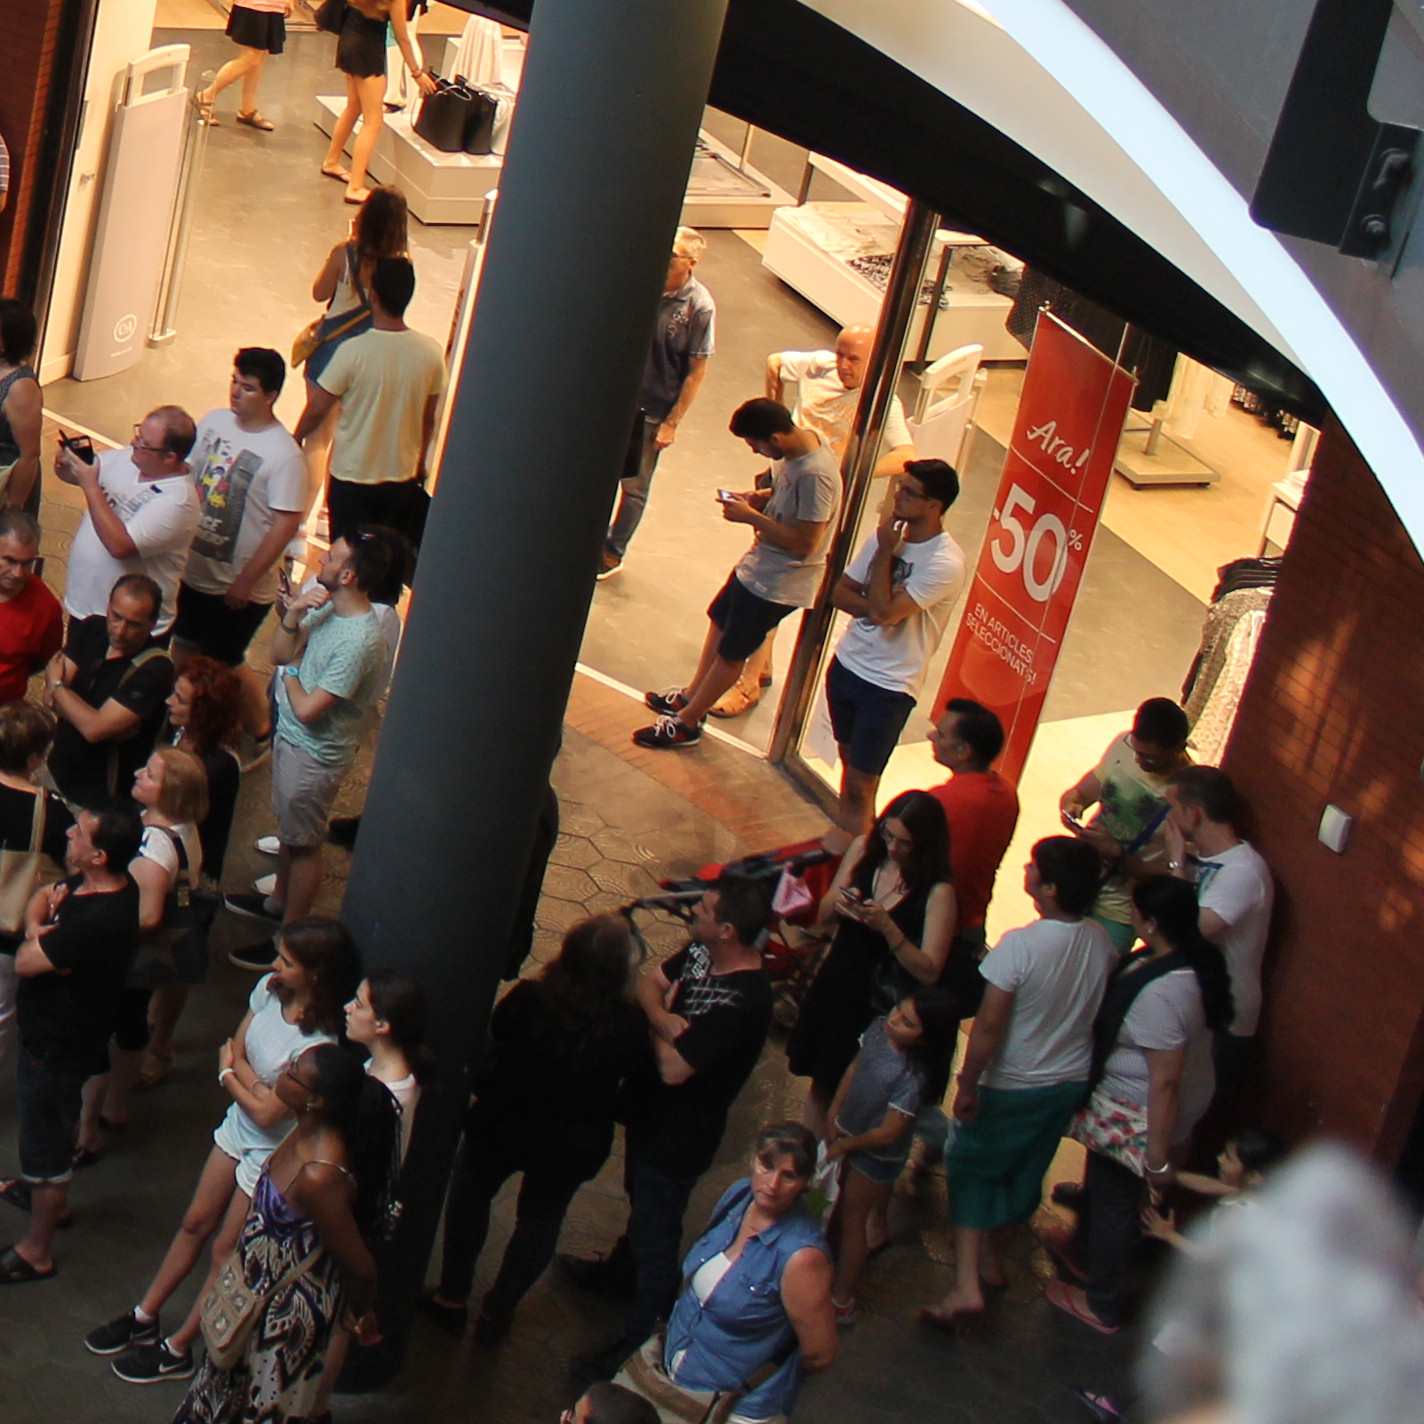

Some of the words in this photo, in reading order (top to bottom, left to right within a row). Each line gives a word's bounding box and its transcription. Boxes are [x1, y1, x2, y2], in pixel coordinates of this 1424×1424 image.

[1027, 420, 1090, 475] Ara!
[966, 612, 1038, 686] SELECCIONATS!
[975, 602, 990, 624] EN
[987, 614, 1034, 664] ARTICLES
